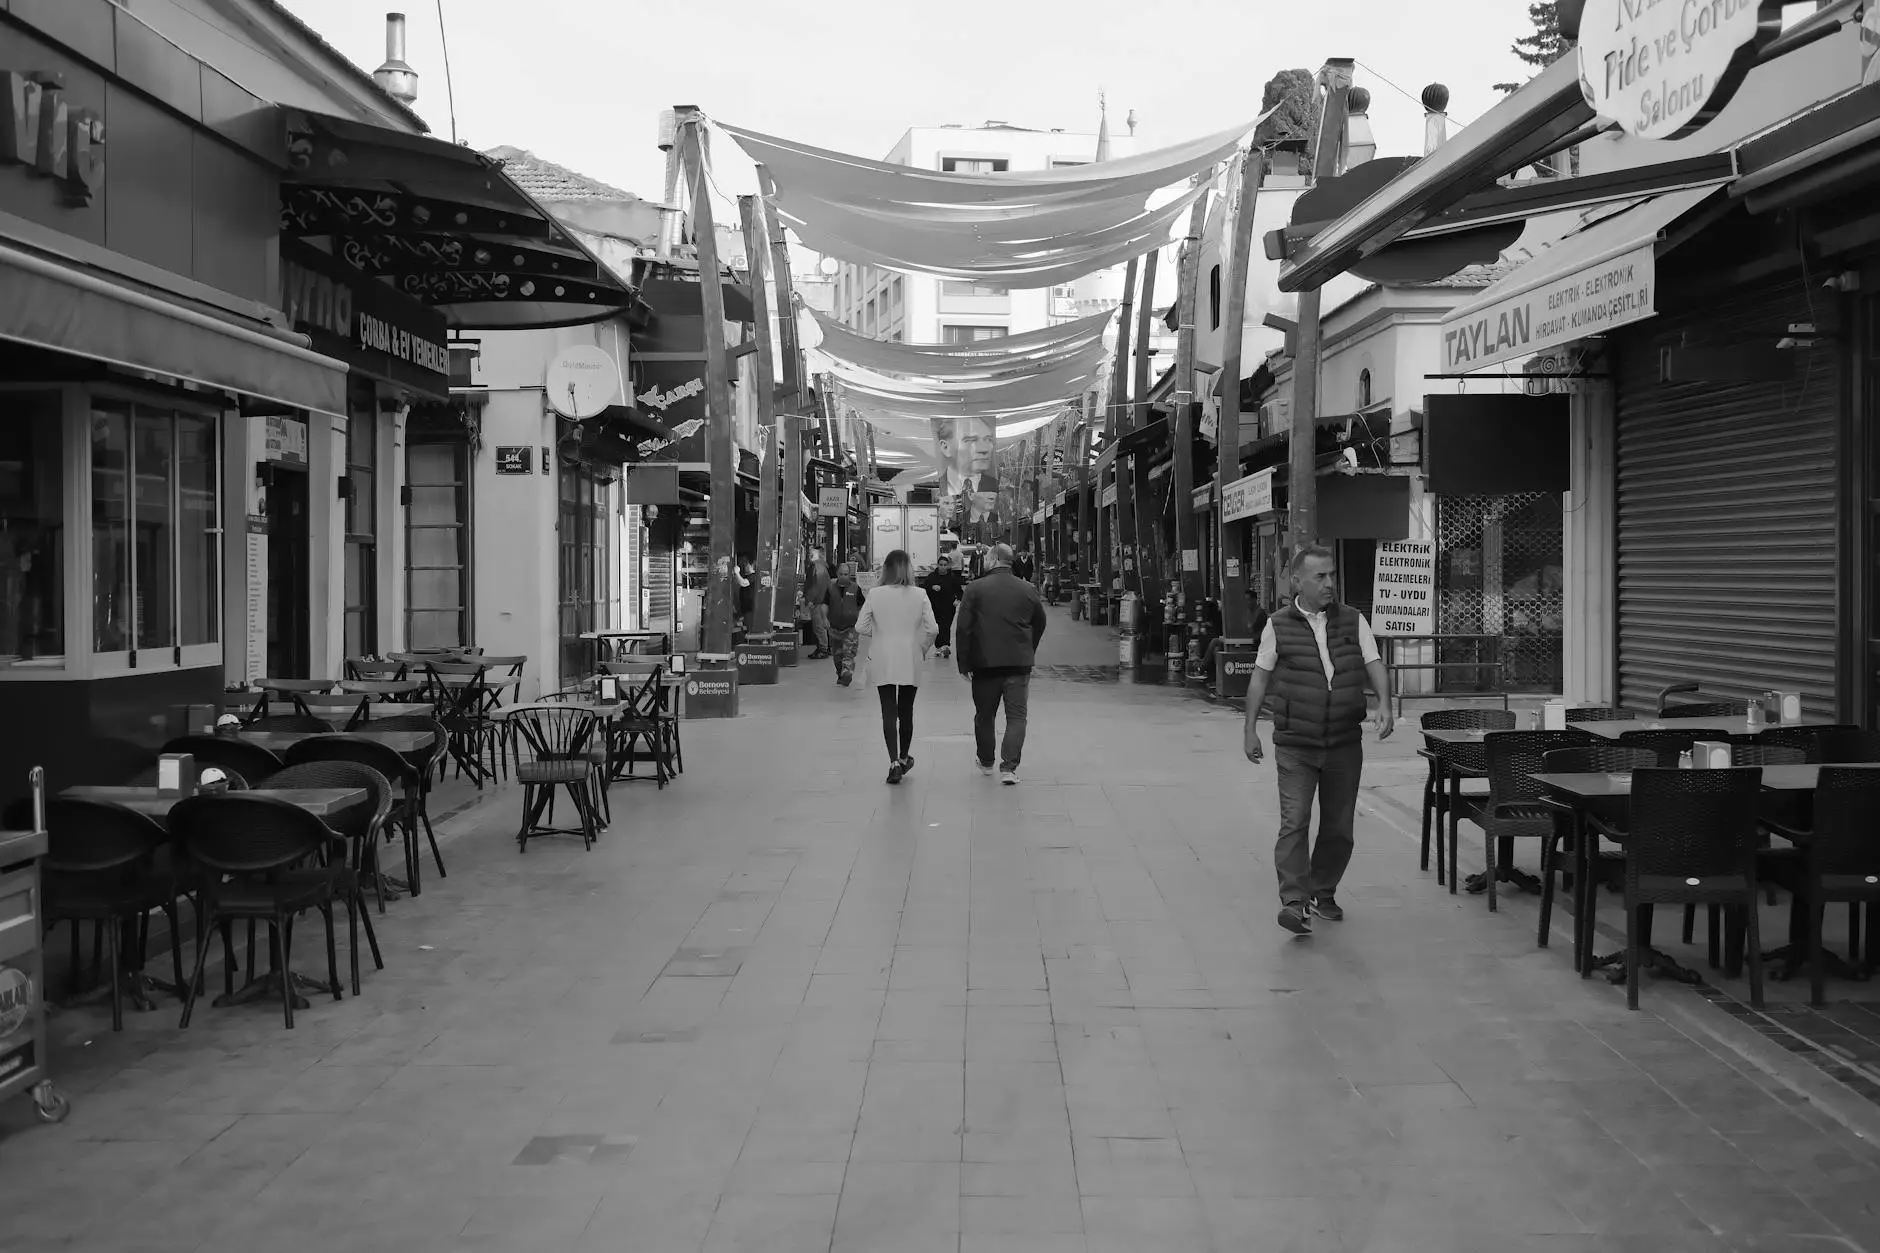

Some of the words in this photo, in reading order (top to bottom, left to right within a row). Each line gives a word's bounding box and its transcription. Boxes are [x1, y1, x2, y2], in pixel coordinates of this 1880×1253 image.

[1603, 36, 1650, 99] Pide
[1654, 29, 1677, 67] ve
[1639, 73, 1704, 132] Salonu
[1445, 302, 1531, 367] TAYLAN
[1571, 303, 1607, 329] KUMANDA
[359, 311, 391, 351] ÇORBA
[400, 329, 410, 361] EV
[1375, 605, 1430, 616] KUMANDALARI
[1379, 589, 1391, 599] TV
[1400, 590, 1427, 600] UYDU
[699, 687, 730, 695] Belediyesi
